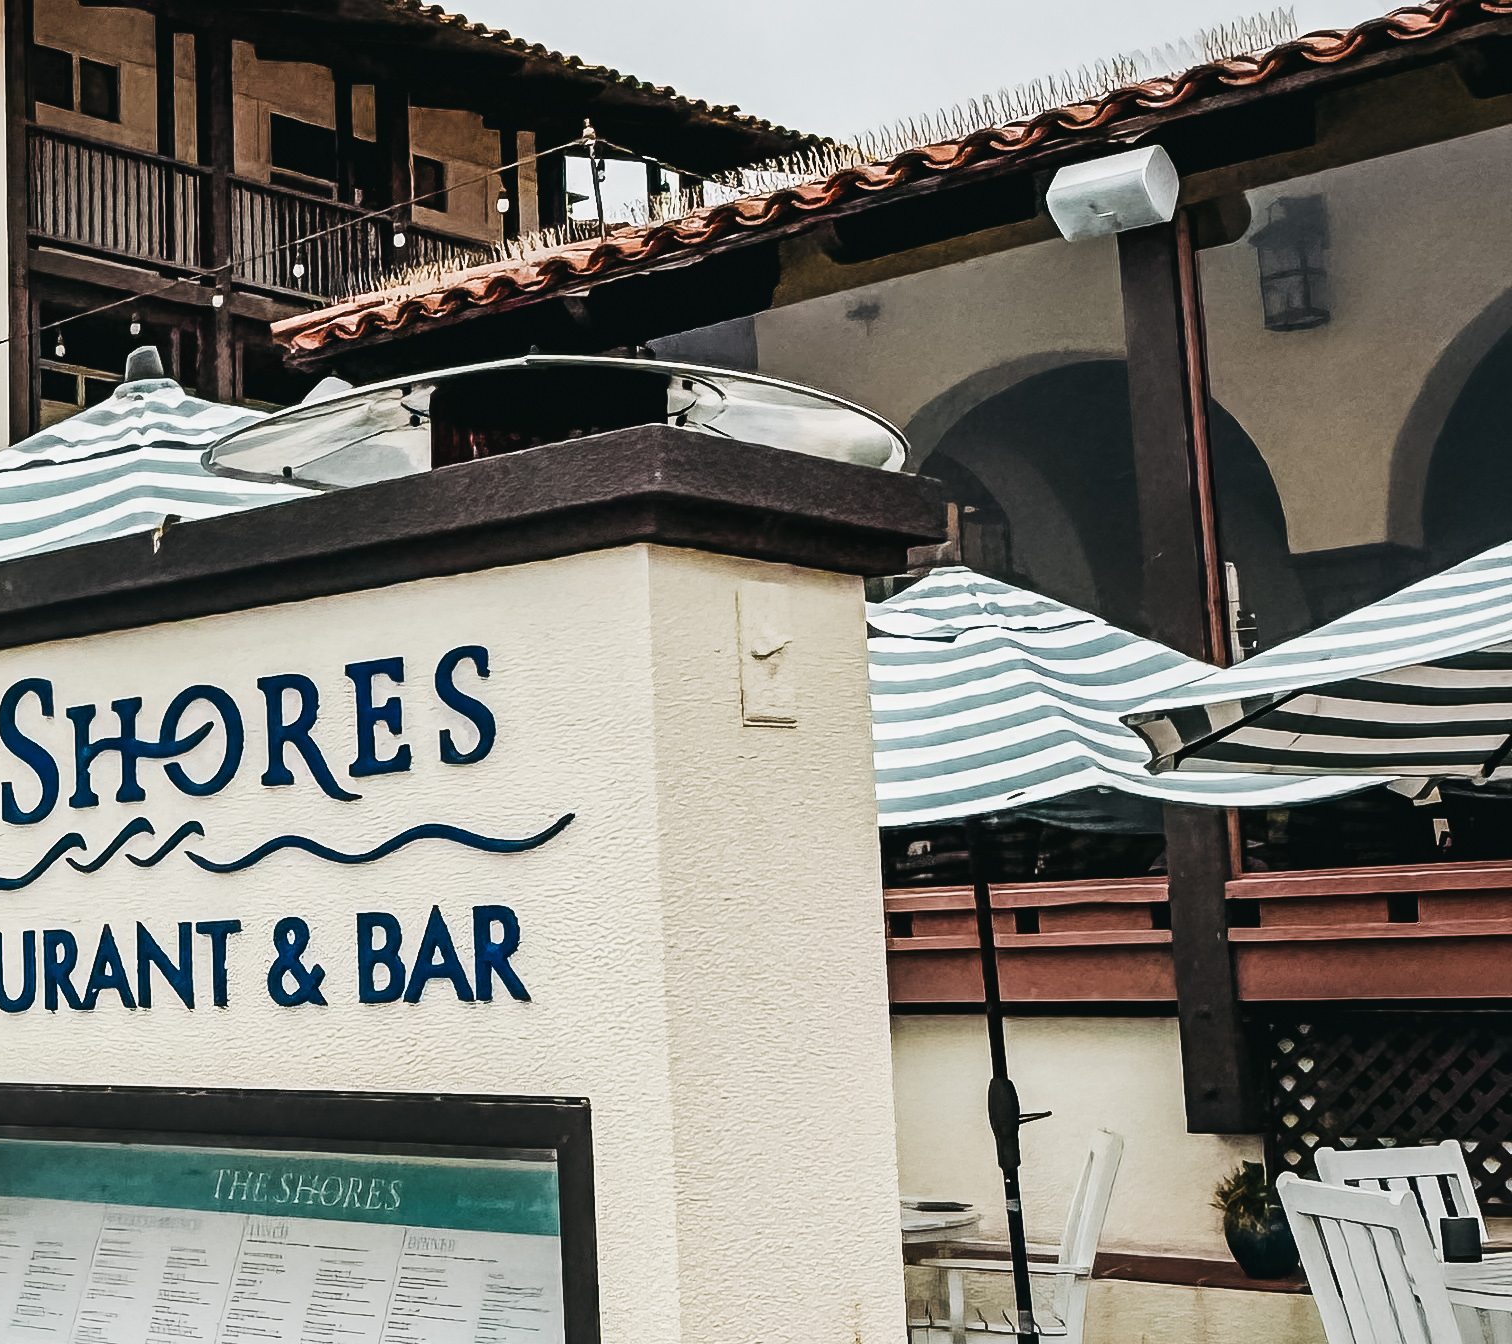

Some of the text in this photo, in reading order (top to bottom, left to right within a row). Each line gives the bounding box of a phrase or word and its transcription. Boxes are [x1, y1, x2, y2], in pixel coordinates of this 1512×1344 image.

[266, 915, 328, 1007] &
[356, 904, 532, 1004] BAR
[213, 1168, 403, 1210] THE SHORES
